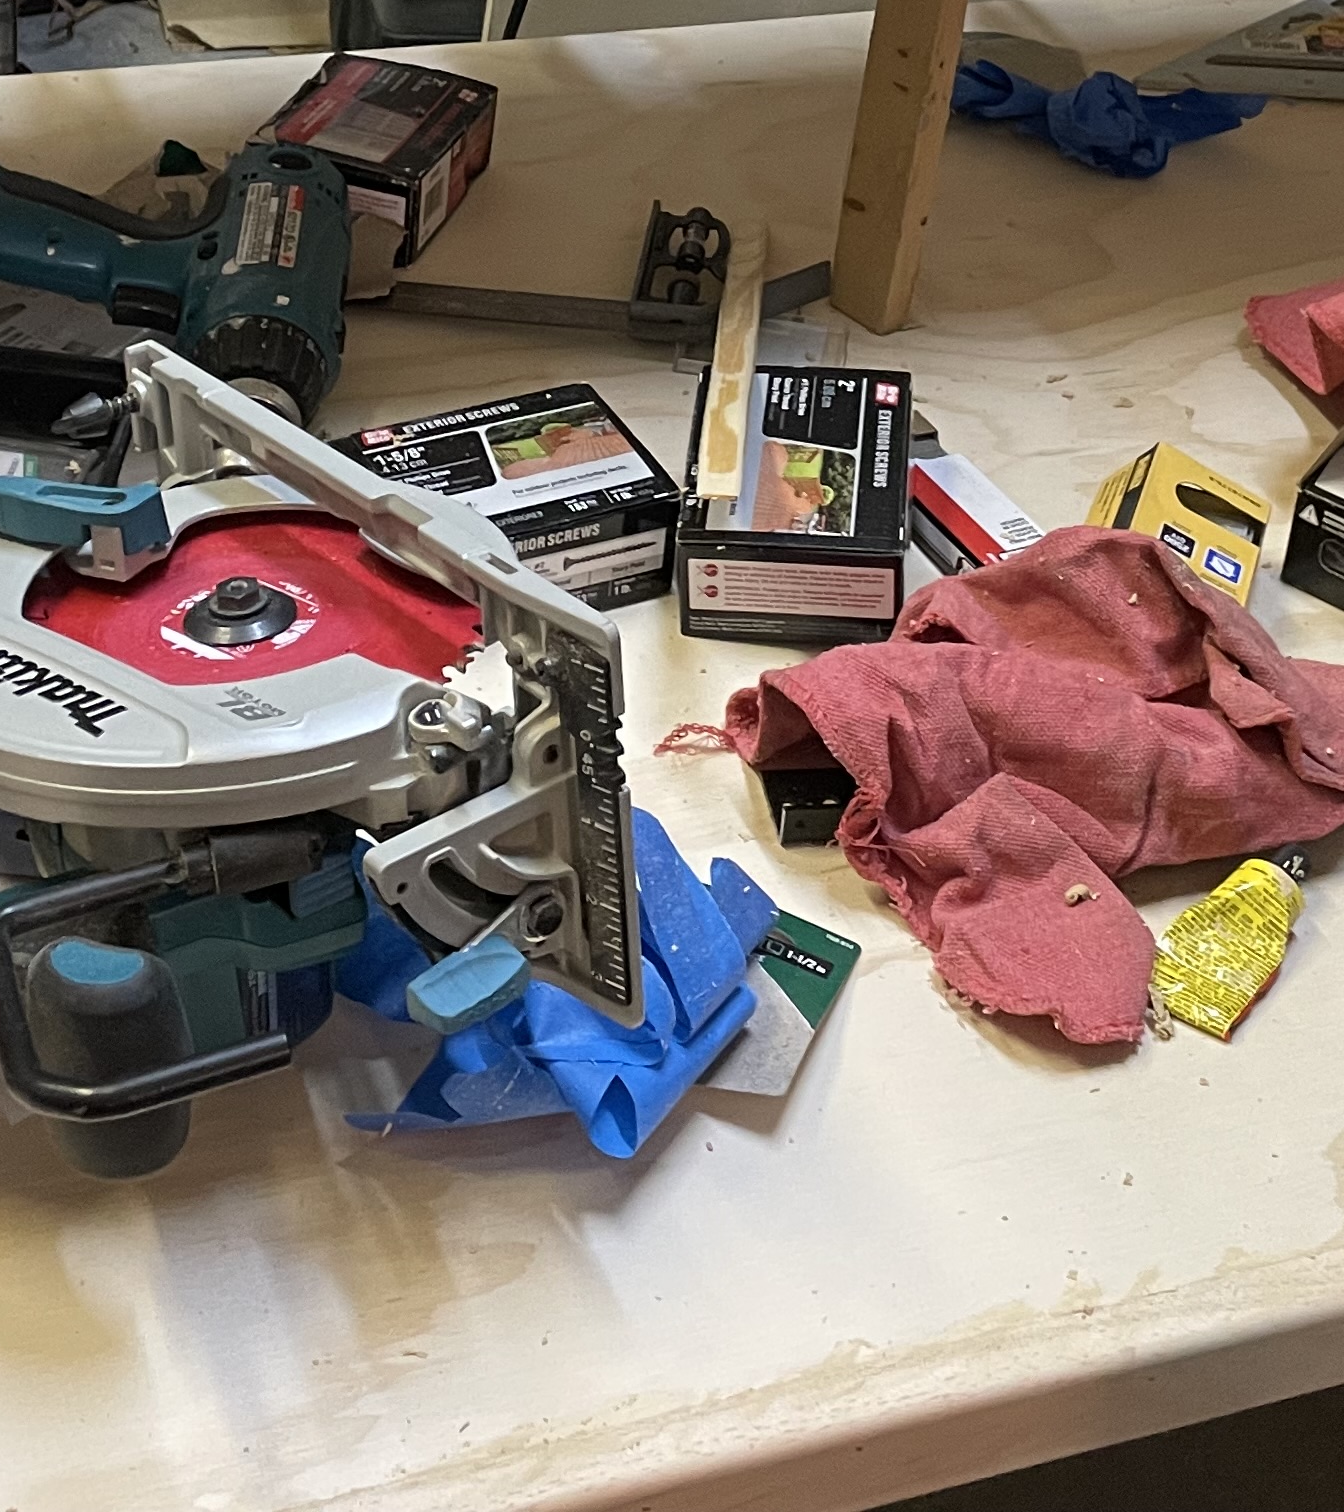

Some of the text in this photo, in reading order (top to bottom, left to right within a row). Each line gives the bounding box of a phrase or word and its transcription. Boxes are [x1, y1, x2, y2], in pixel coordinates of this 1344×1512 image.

[402, 402, 520, 435] EXTERIOR SCREWS
[875, 409, 893, 450] EXTERIOR
[872, 451, 889, 488] SCREWS
[515, 523, 601, 553] RIOR SCREWS
